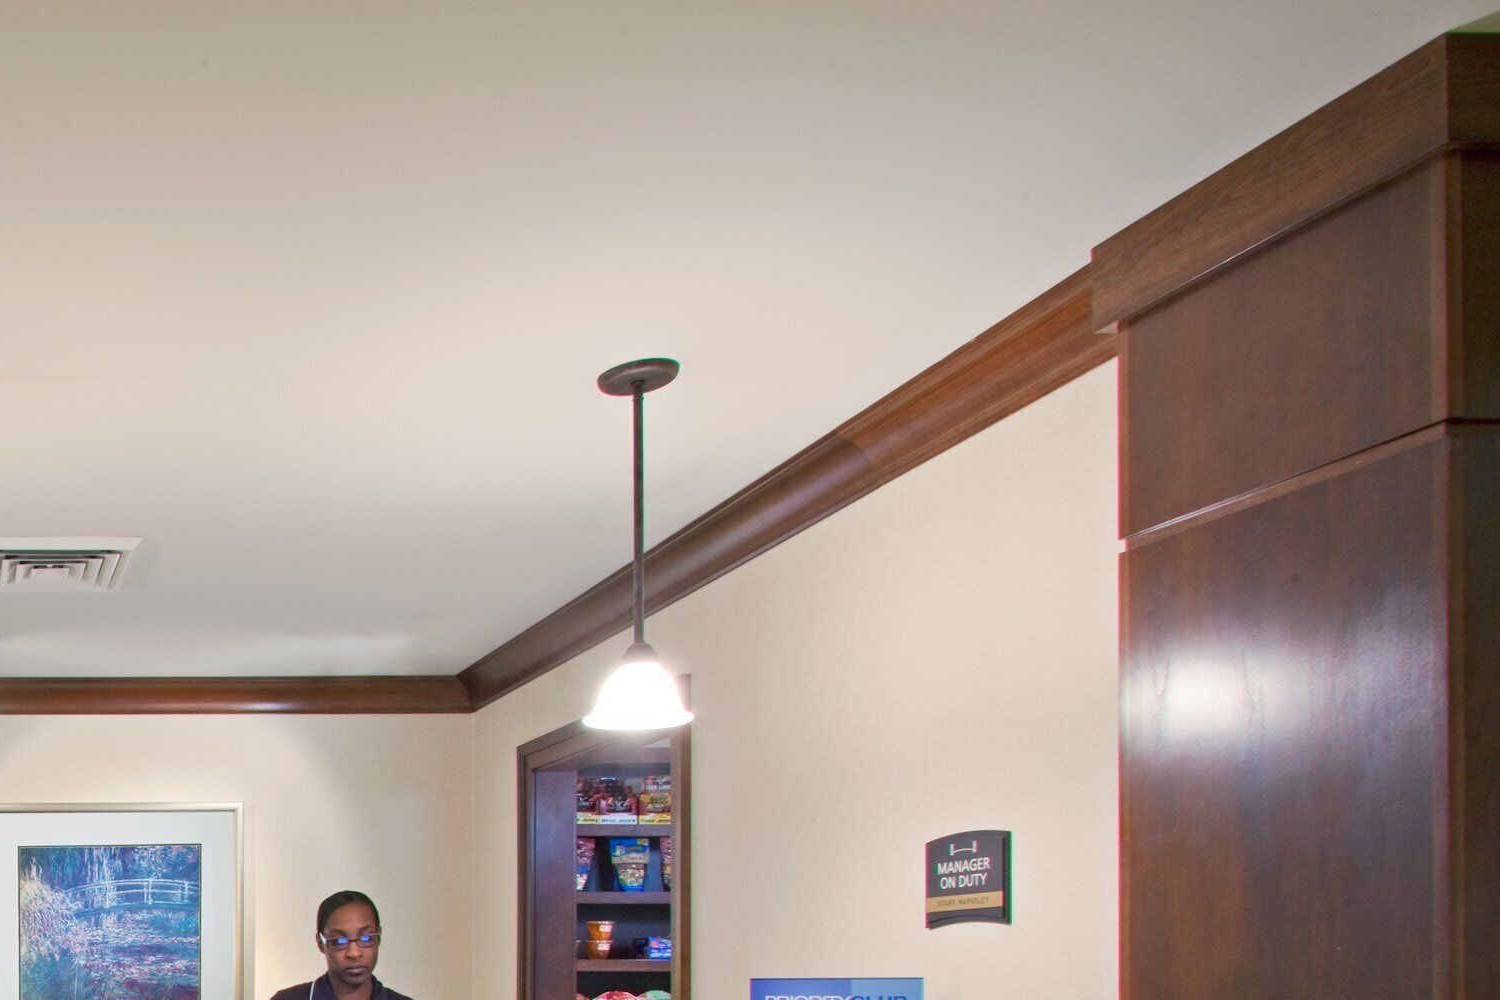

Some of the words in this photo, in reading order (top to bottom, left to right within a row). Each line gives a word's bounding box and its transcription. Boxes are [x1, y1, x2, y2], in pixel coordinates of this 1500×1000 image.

[937, 857, 990, 875] MANAGER
[940, 877, 956, 890] ON
[958, 873, 988, 888] DUTY
